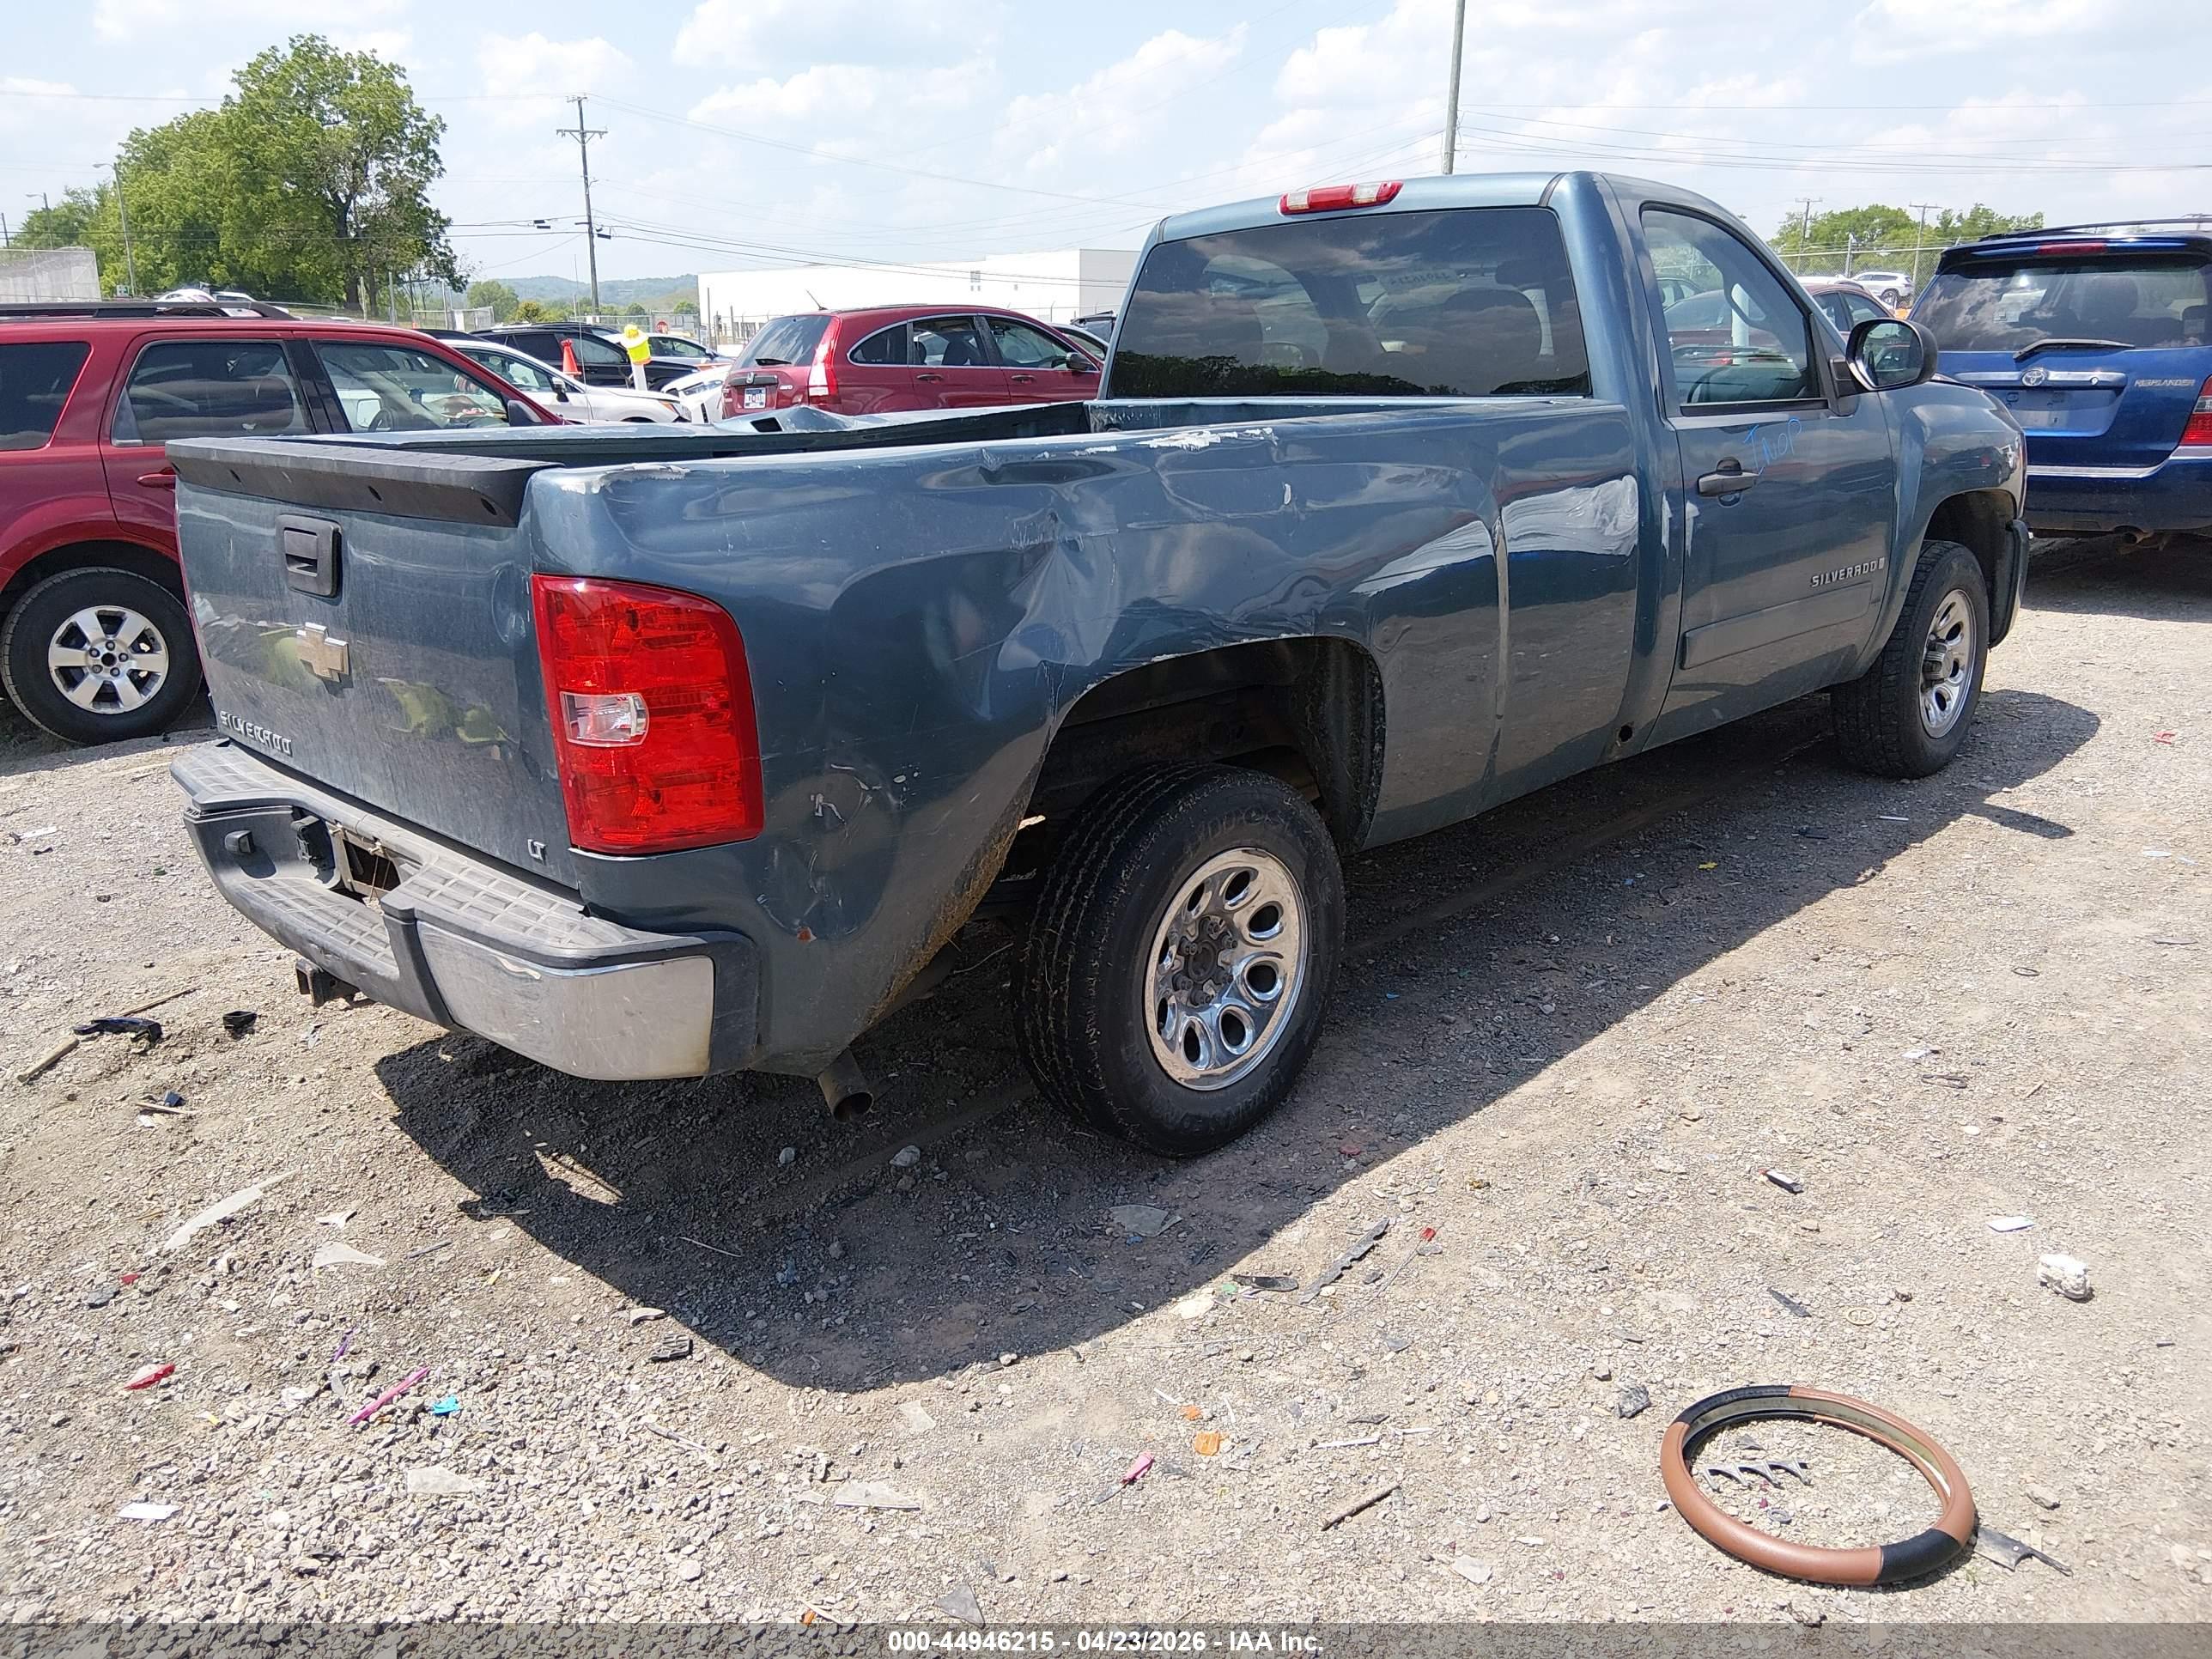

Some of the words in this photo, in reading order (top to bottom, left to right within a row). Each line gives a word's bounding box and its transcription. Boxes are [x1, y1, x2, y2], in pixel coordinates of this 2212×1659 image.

[2133, 379, 2196, 387] HIGHLANDER
[1811, 561, 1877, 587] SILVERADO
[220, 710, 292, 756] SILVERADO
[527, 838, 546, 860] LT
